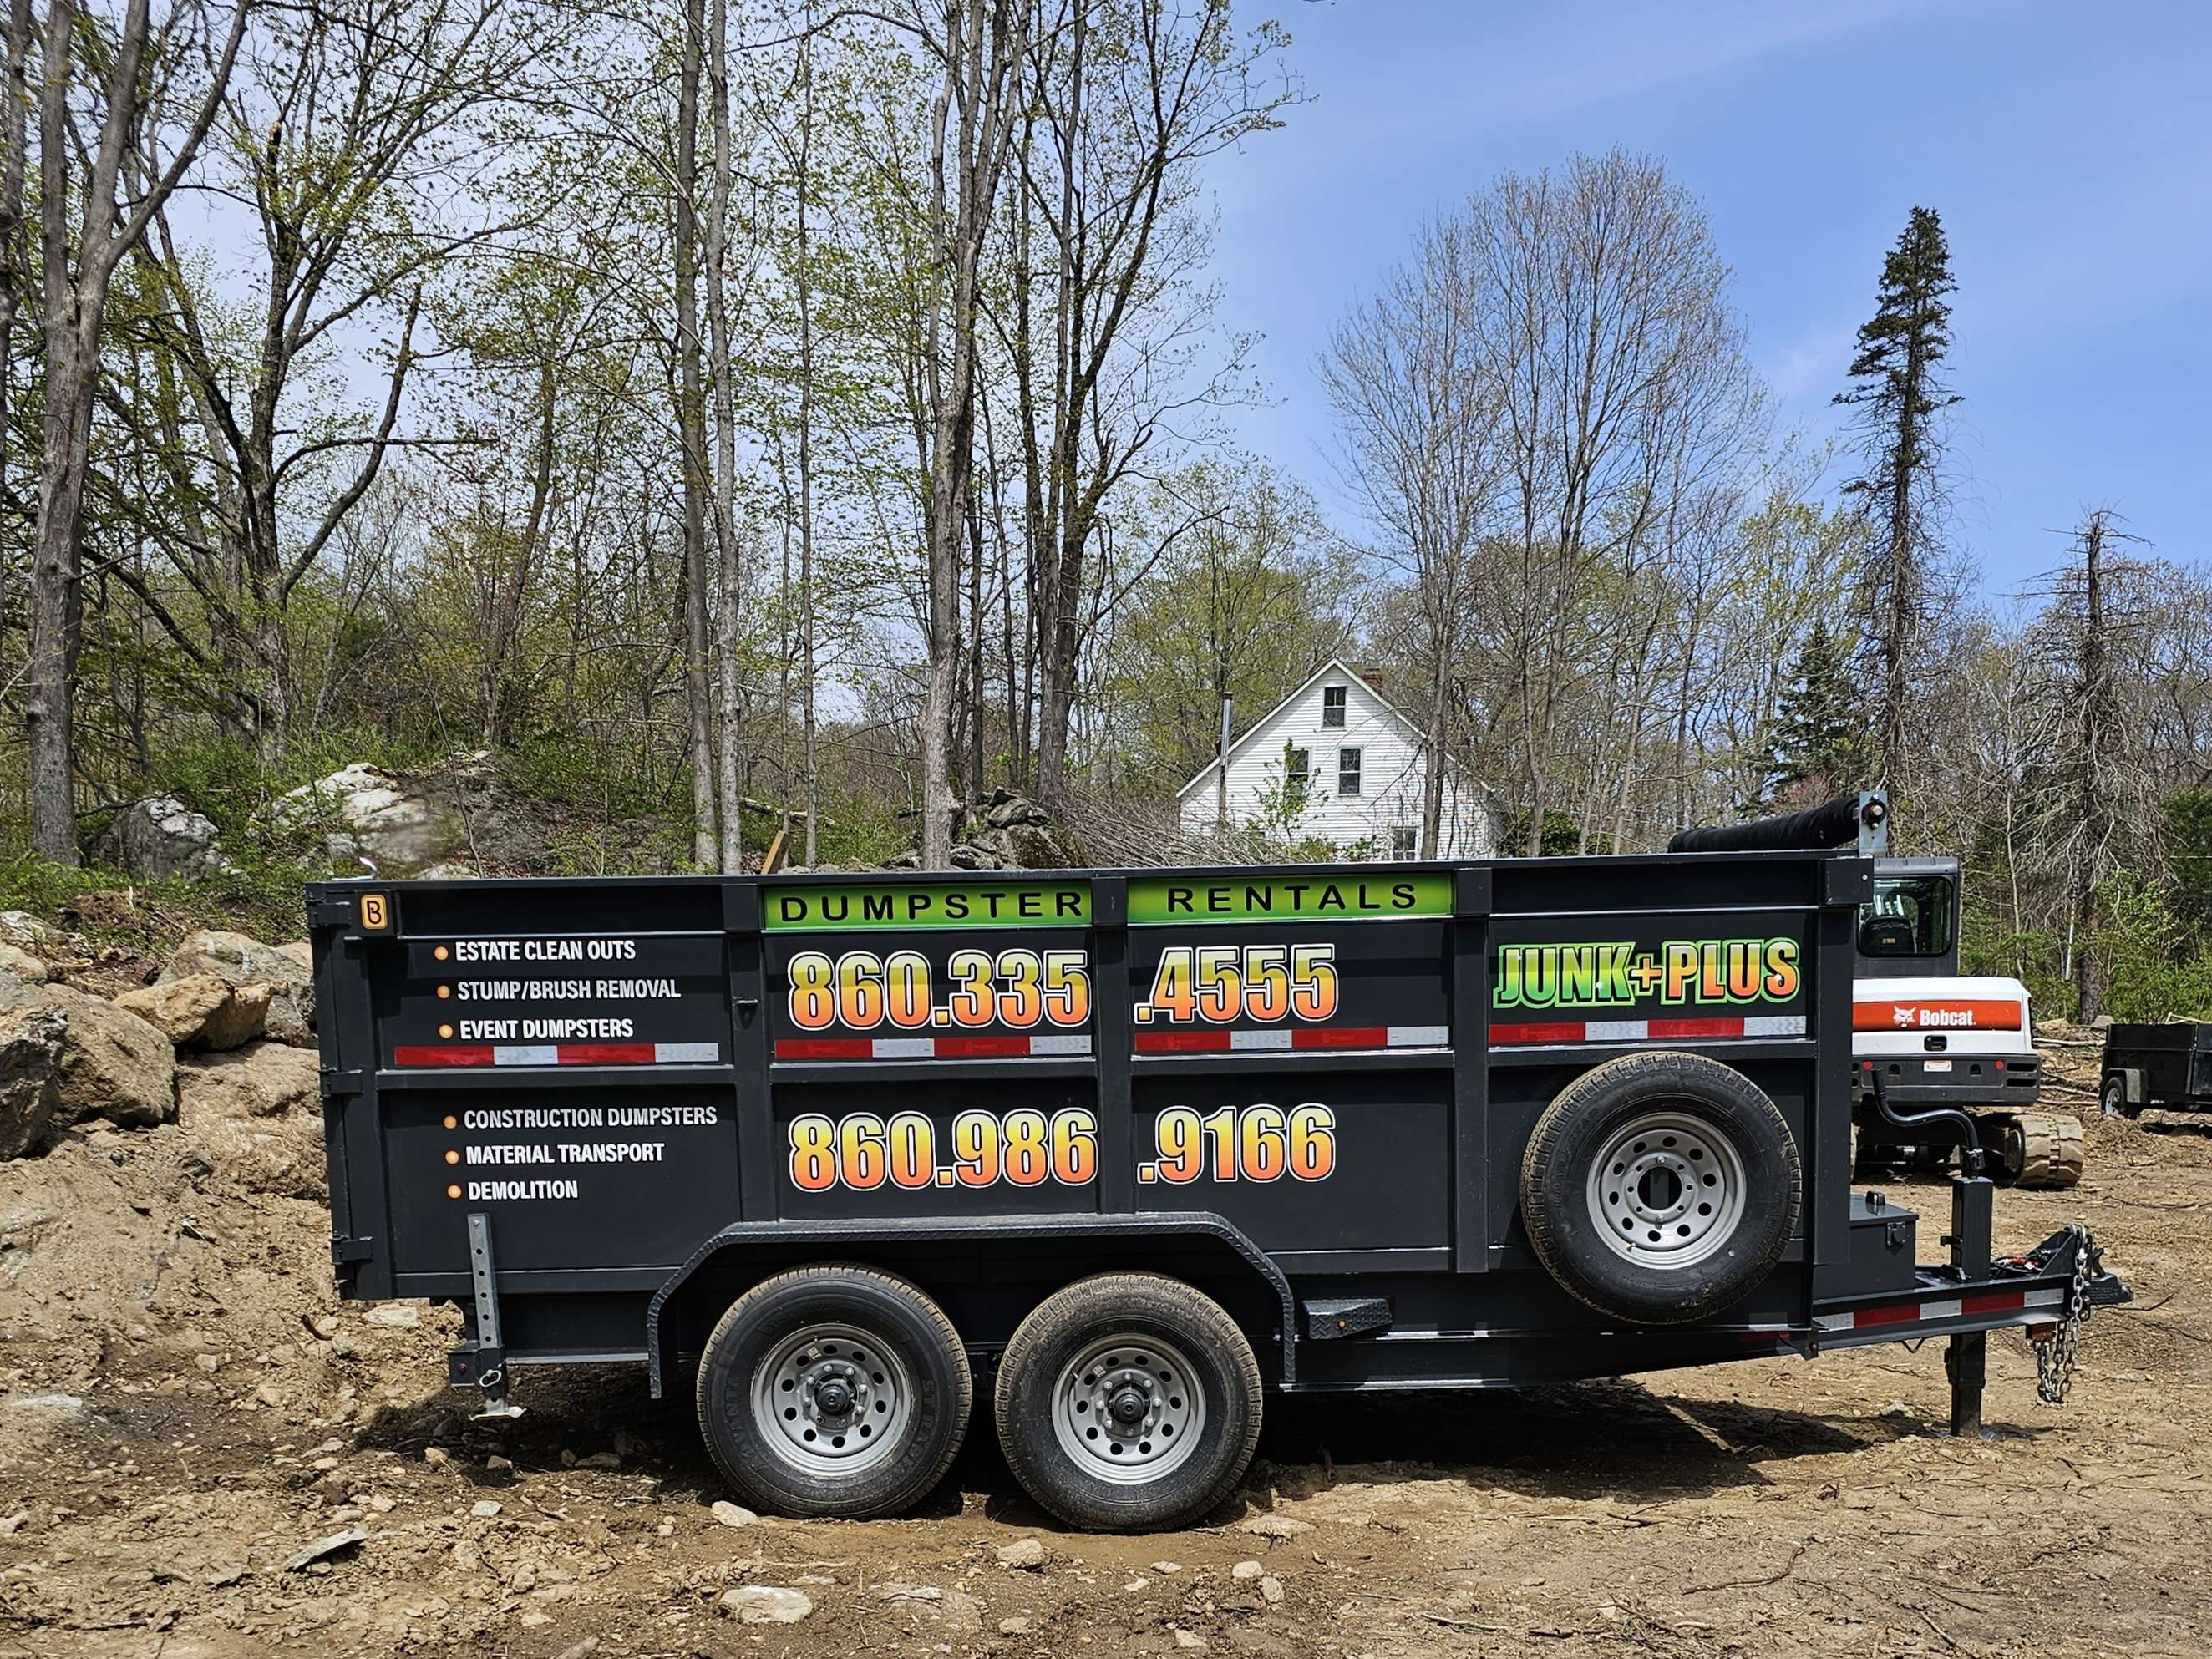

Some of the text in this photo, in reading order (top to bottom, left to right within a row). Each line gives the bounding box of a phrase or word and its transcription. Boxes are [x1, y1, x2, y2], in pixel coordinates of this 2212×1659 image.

[780, 883, 1418, 922] DUMPSTER RENTALS
[456, 940, 637, 961] ESTATE CLEAN OUTS
[457, 979, 682, 1001] STUMP/BRUSH REMOVAL
[788, 949, 1092, 1031] 860.335
[459, 1018, 634, 1039] EVENT DUMPSTERS
[1919, 1008, 1974, 1027] Bobcat
[464, 1106, 718, 1129] CONSTRUCTION DUMPSTERS
[465, 1142, 665, 1165] MATERIAL TRANSPORT
[788, 1108, 1098, 1192] 860.986
[468, 1180, 578, 1200] DEMOLITION
